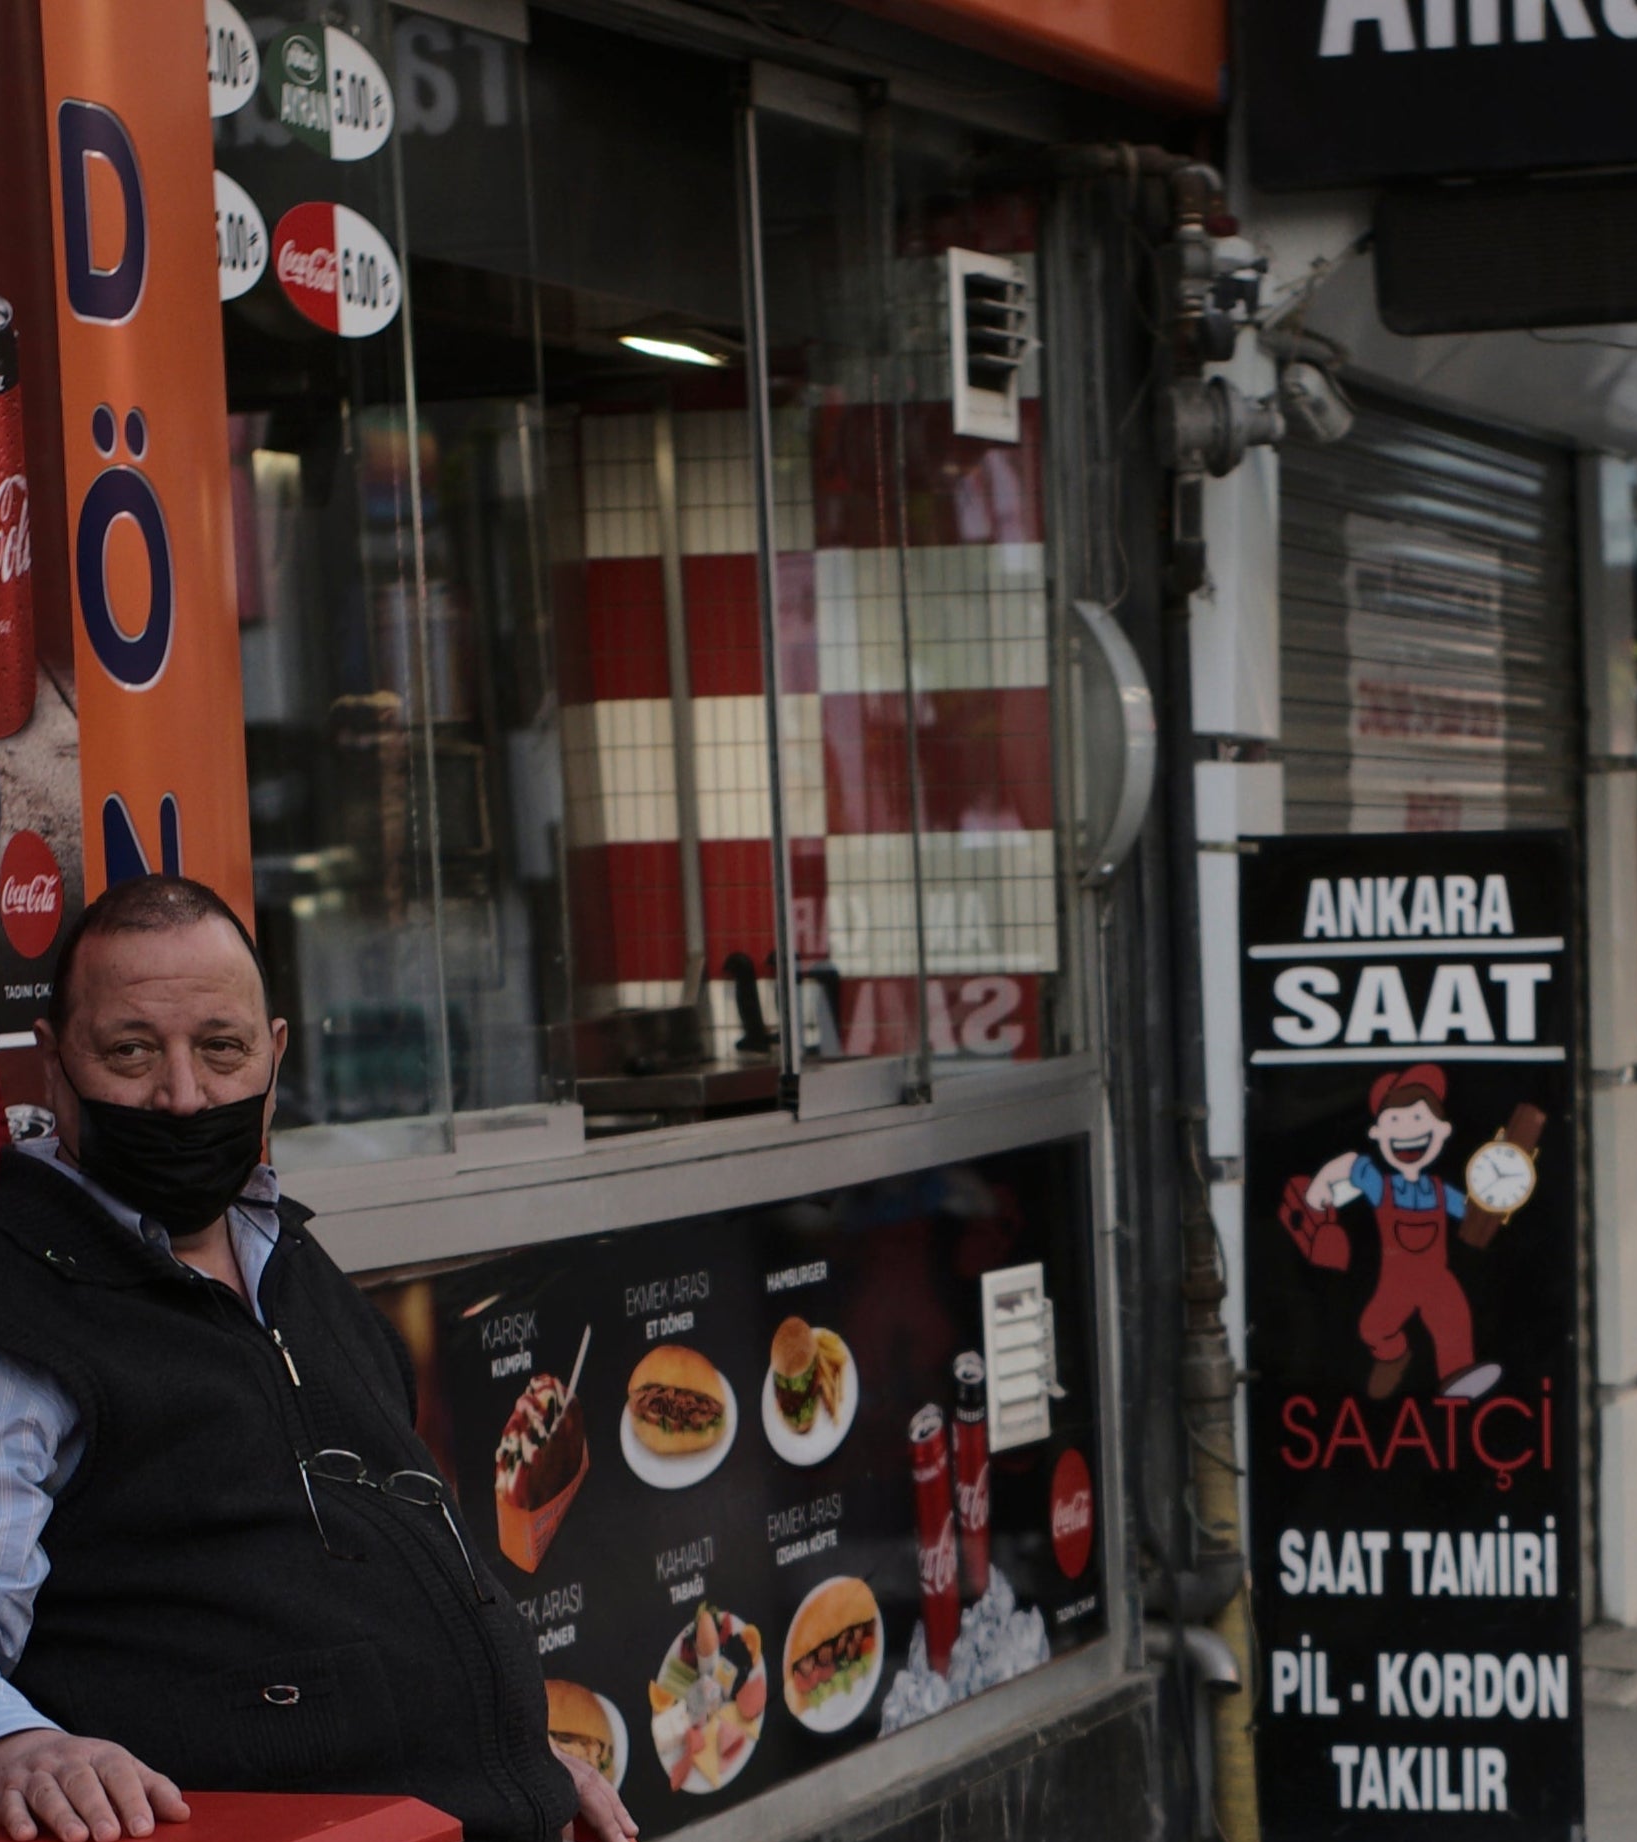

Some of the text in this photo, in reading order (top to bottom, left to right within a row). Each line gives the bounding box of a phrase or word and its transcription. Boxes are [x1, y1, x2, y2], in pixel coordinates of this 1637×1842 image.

[1302, 872, 1515, 942] ANKARA
[1271, 963, 1552, 1047] SAAT
[625, 1271, 711, 1317] EKMEK ARASI
[766, 1260, 829, 1293] HAMBURGER
[645, 1310, 695, 1340] ET DÖNER
[1279, 1377, 1555, 1492] SAATÇİ
[1278, 1516, 1559, 1599] SAAT TAMİRİ
[542, 1582, 584, 1623] ARASI
[538, 1624, 576, 1655] DÖNER
[1271, 1633, 1341, 1719] PİL
[1377, 1652, 1570, 1720] KORDON
[1331, 1744, 1509, 1813] TAKILIR
